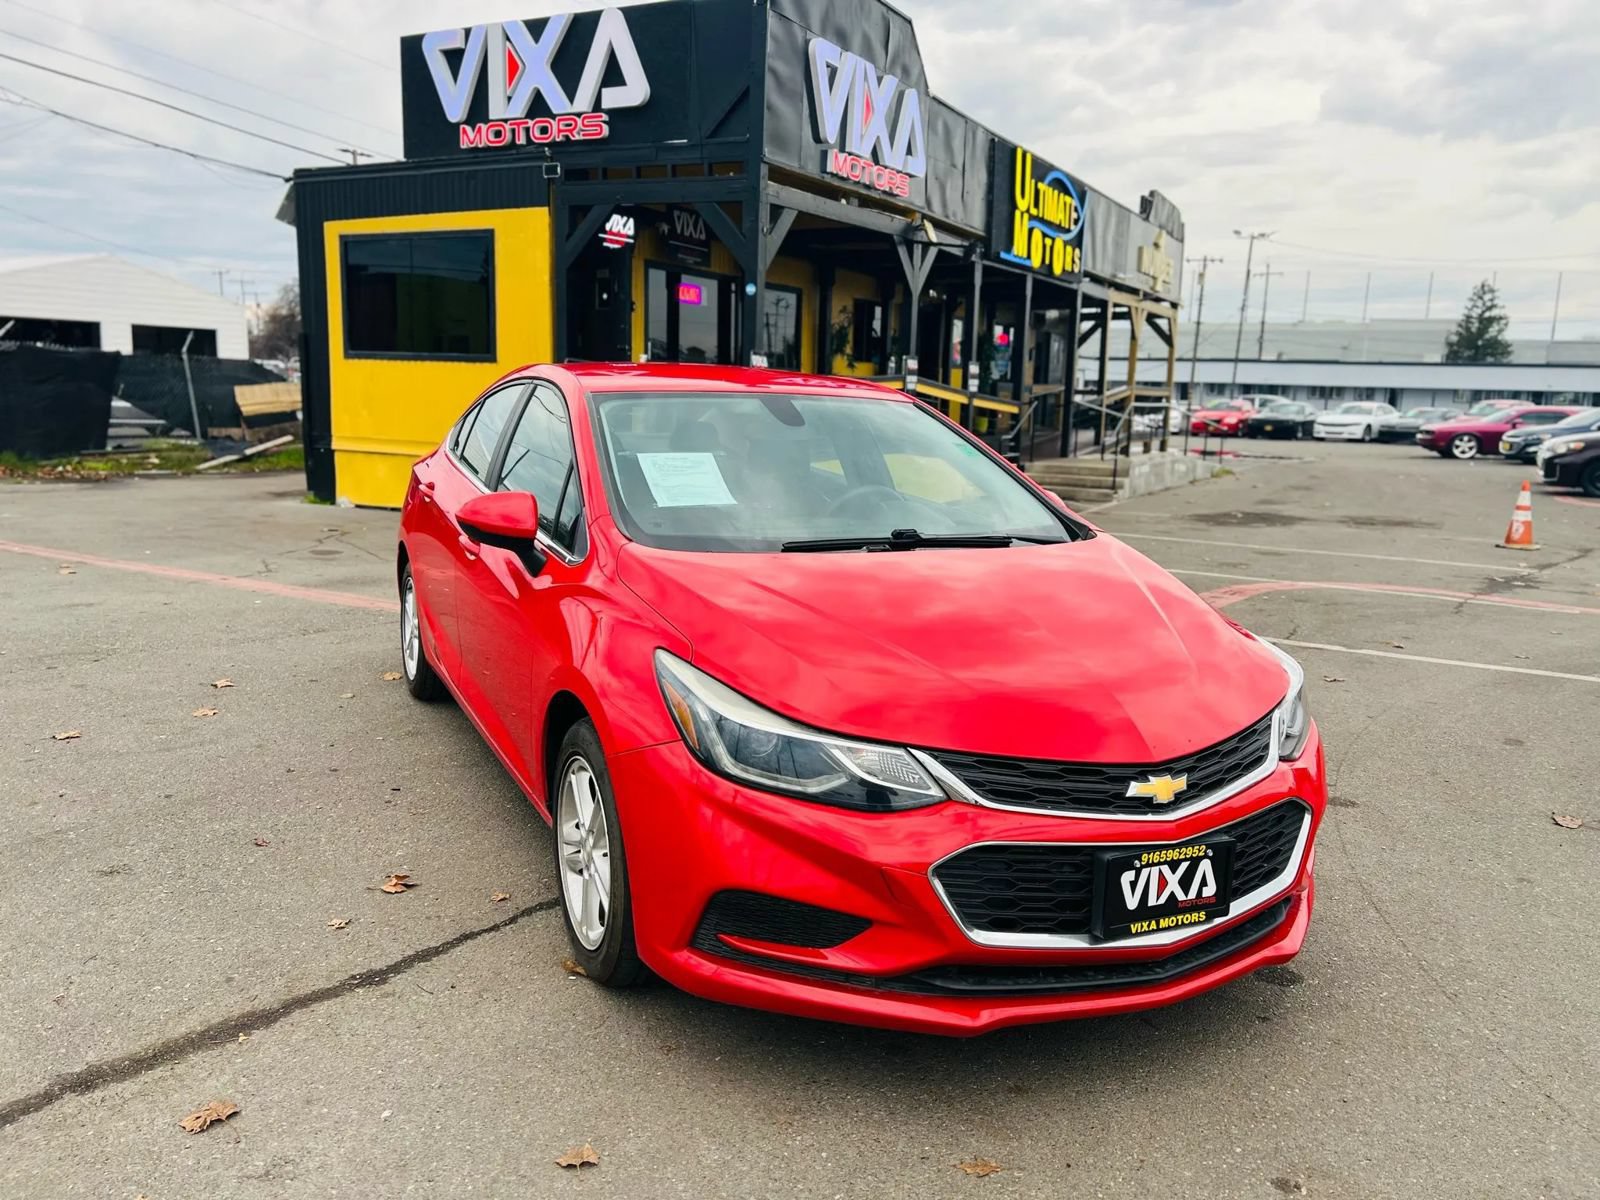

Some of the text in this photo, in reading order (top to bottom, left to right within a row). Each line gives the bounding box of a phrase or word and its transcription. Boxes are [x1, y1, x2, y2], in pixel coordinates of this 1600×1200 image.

[422, 7, 650, 123] VIXA
[459, 113, 608, 149] MOTORS
[808, 37, 926, 178] VIXA
[830, 149, 910, 198] MOTORS
[1015, 146, 1078, 231] ULTIMATE
[673, 209, 706, 240] VIXA
[1013, 208, 1081, 276] MOTORS
[1141, 845, 1206, 865] 9165962952
[1120, 858, 1217, 911] VIXA
[1177, 896, 1217, 909] MOTORS
[1130, 911, 1206, 934] VIXA MOTORS
